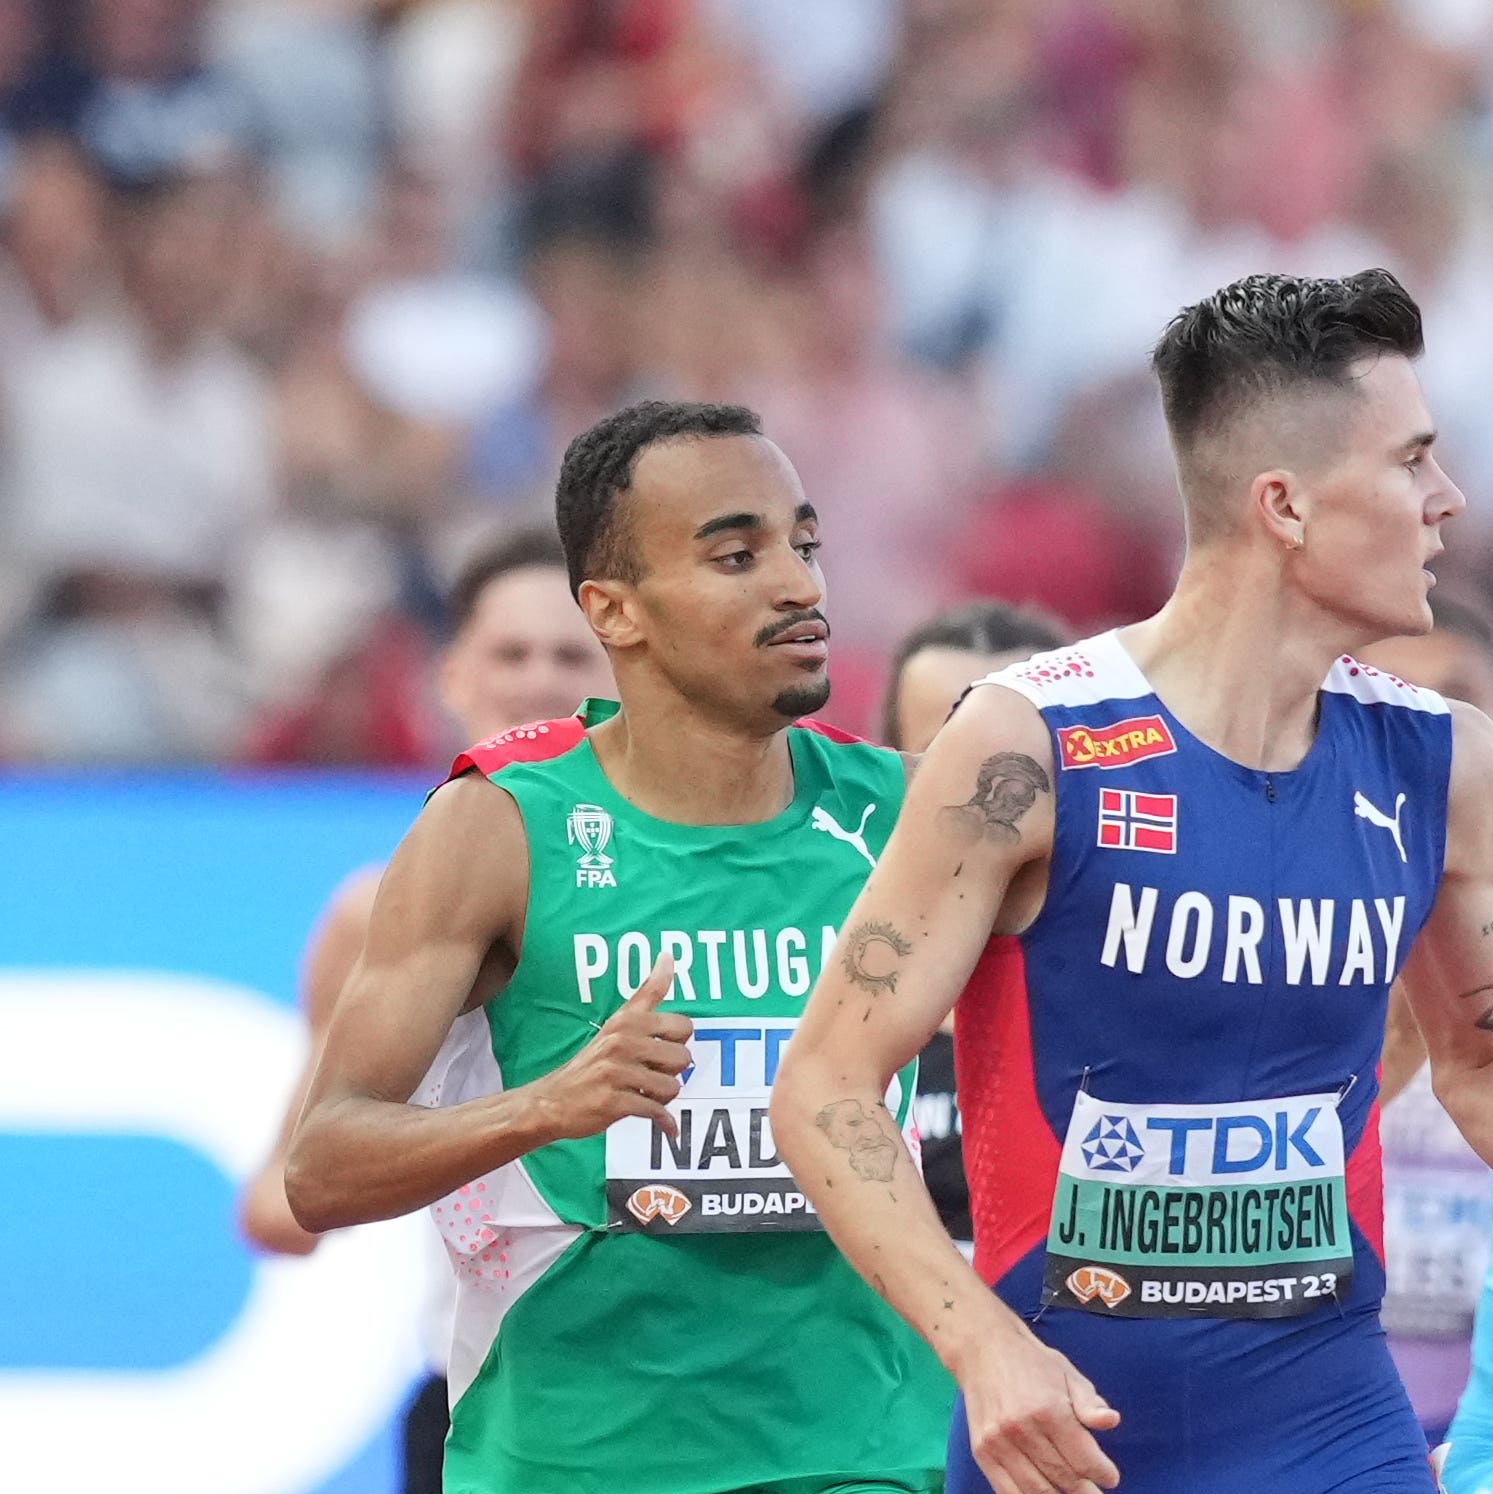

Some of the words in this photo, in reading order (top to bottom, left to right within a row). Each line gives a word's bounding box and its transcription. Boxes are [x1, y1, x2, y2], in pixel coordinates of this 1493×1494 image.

[1094, 727, 1164, 757] EXTRA
[576, 870, 617, 888] FPA
[1100, 882, 1406, 986] NORWAY
[650, 1108, 782, 1170] NAD
[1147, 1107, 1327, 1176] TDK
[1059, 1183, 1086, 1246] J.
[1100, 1182, 1336, 1254] INGEBRIGTSEN
[1140, 1277, 1298, 1303] BUDAPEST
[1301, 1273, 1338, 1298] 23
